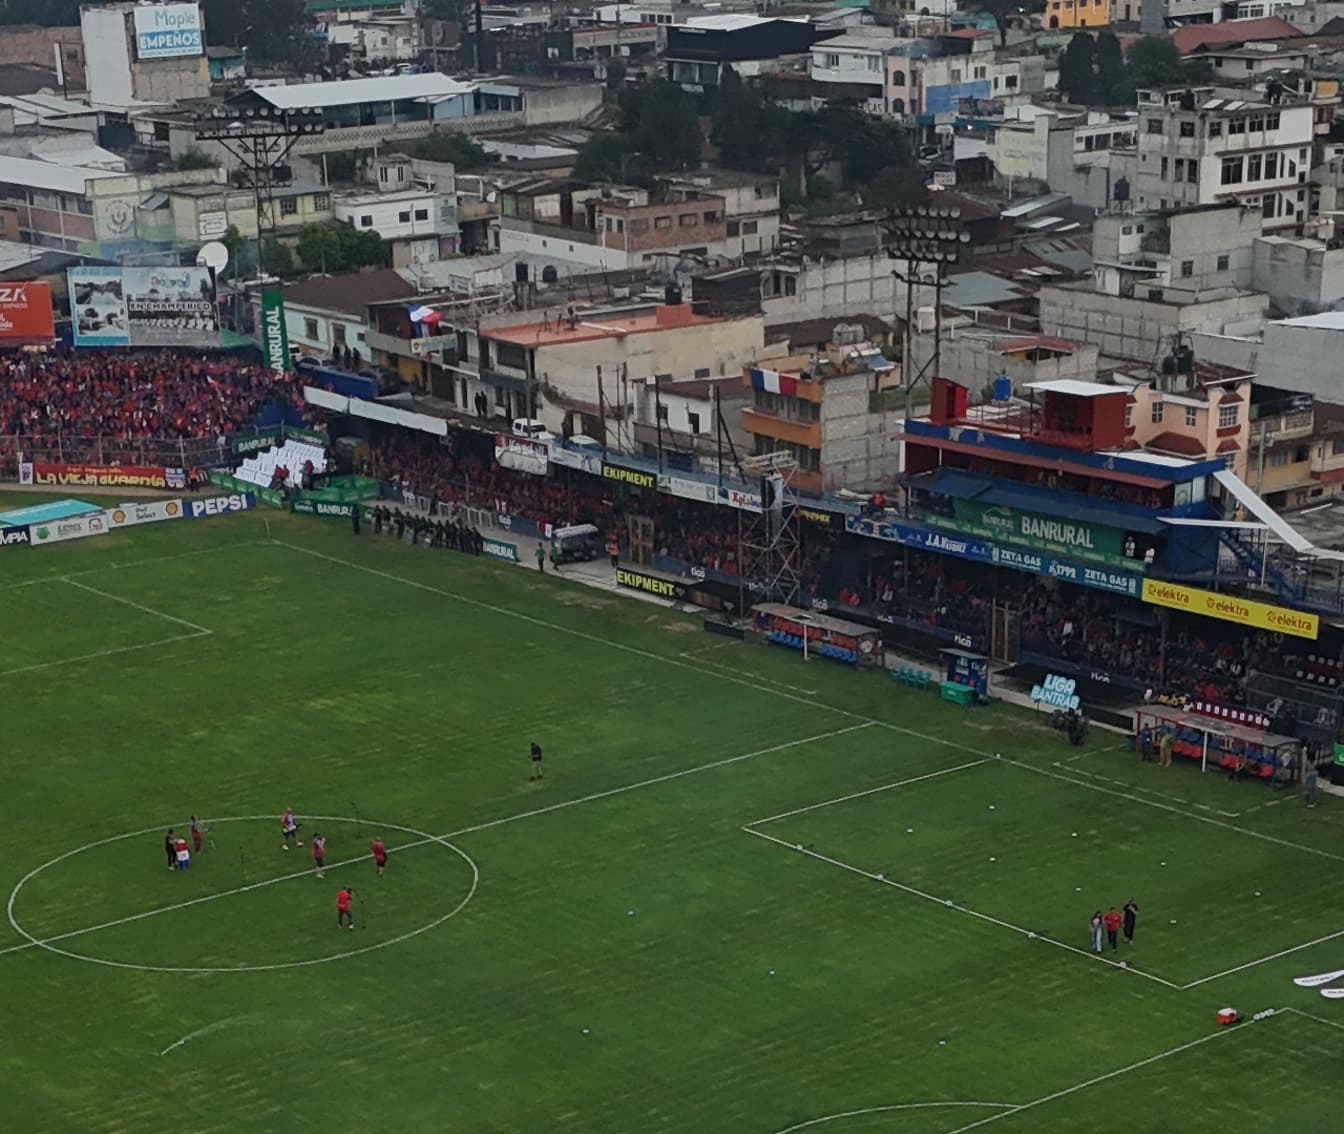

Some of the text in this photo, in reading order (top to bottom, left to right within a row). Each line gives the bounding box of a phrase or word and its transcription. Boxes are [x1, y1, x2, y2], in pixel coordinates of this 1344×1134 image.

[155, 9, 196, 27] Maple
[140, 33, 201, 49] EMPEÑOS
[36, 472, 57, 485] LA
[603, 466, 654, 488] EKIPMENT
[192, 494, 248, 516] PEPSI
[1021, 515, 1094, 549] BANRURAL
[1024, 554, 1042, 567] GAS
[617, 570, 676, 597] EKIPMENT
[1085, 568, 1127, 587] ZETA GAS
[1157, 586, 1189, 604] elektra
[1216, 600, 1249, 617] elektra
[1276, 613, 1312, 631] elektra
[1044, 673, 1077, 695] LIGA
[1030, 685, 1081, 709] BANTRAB
